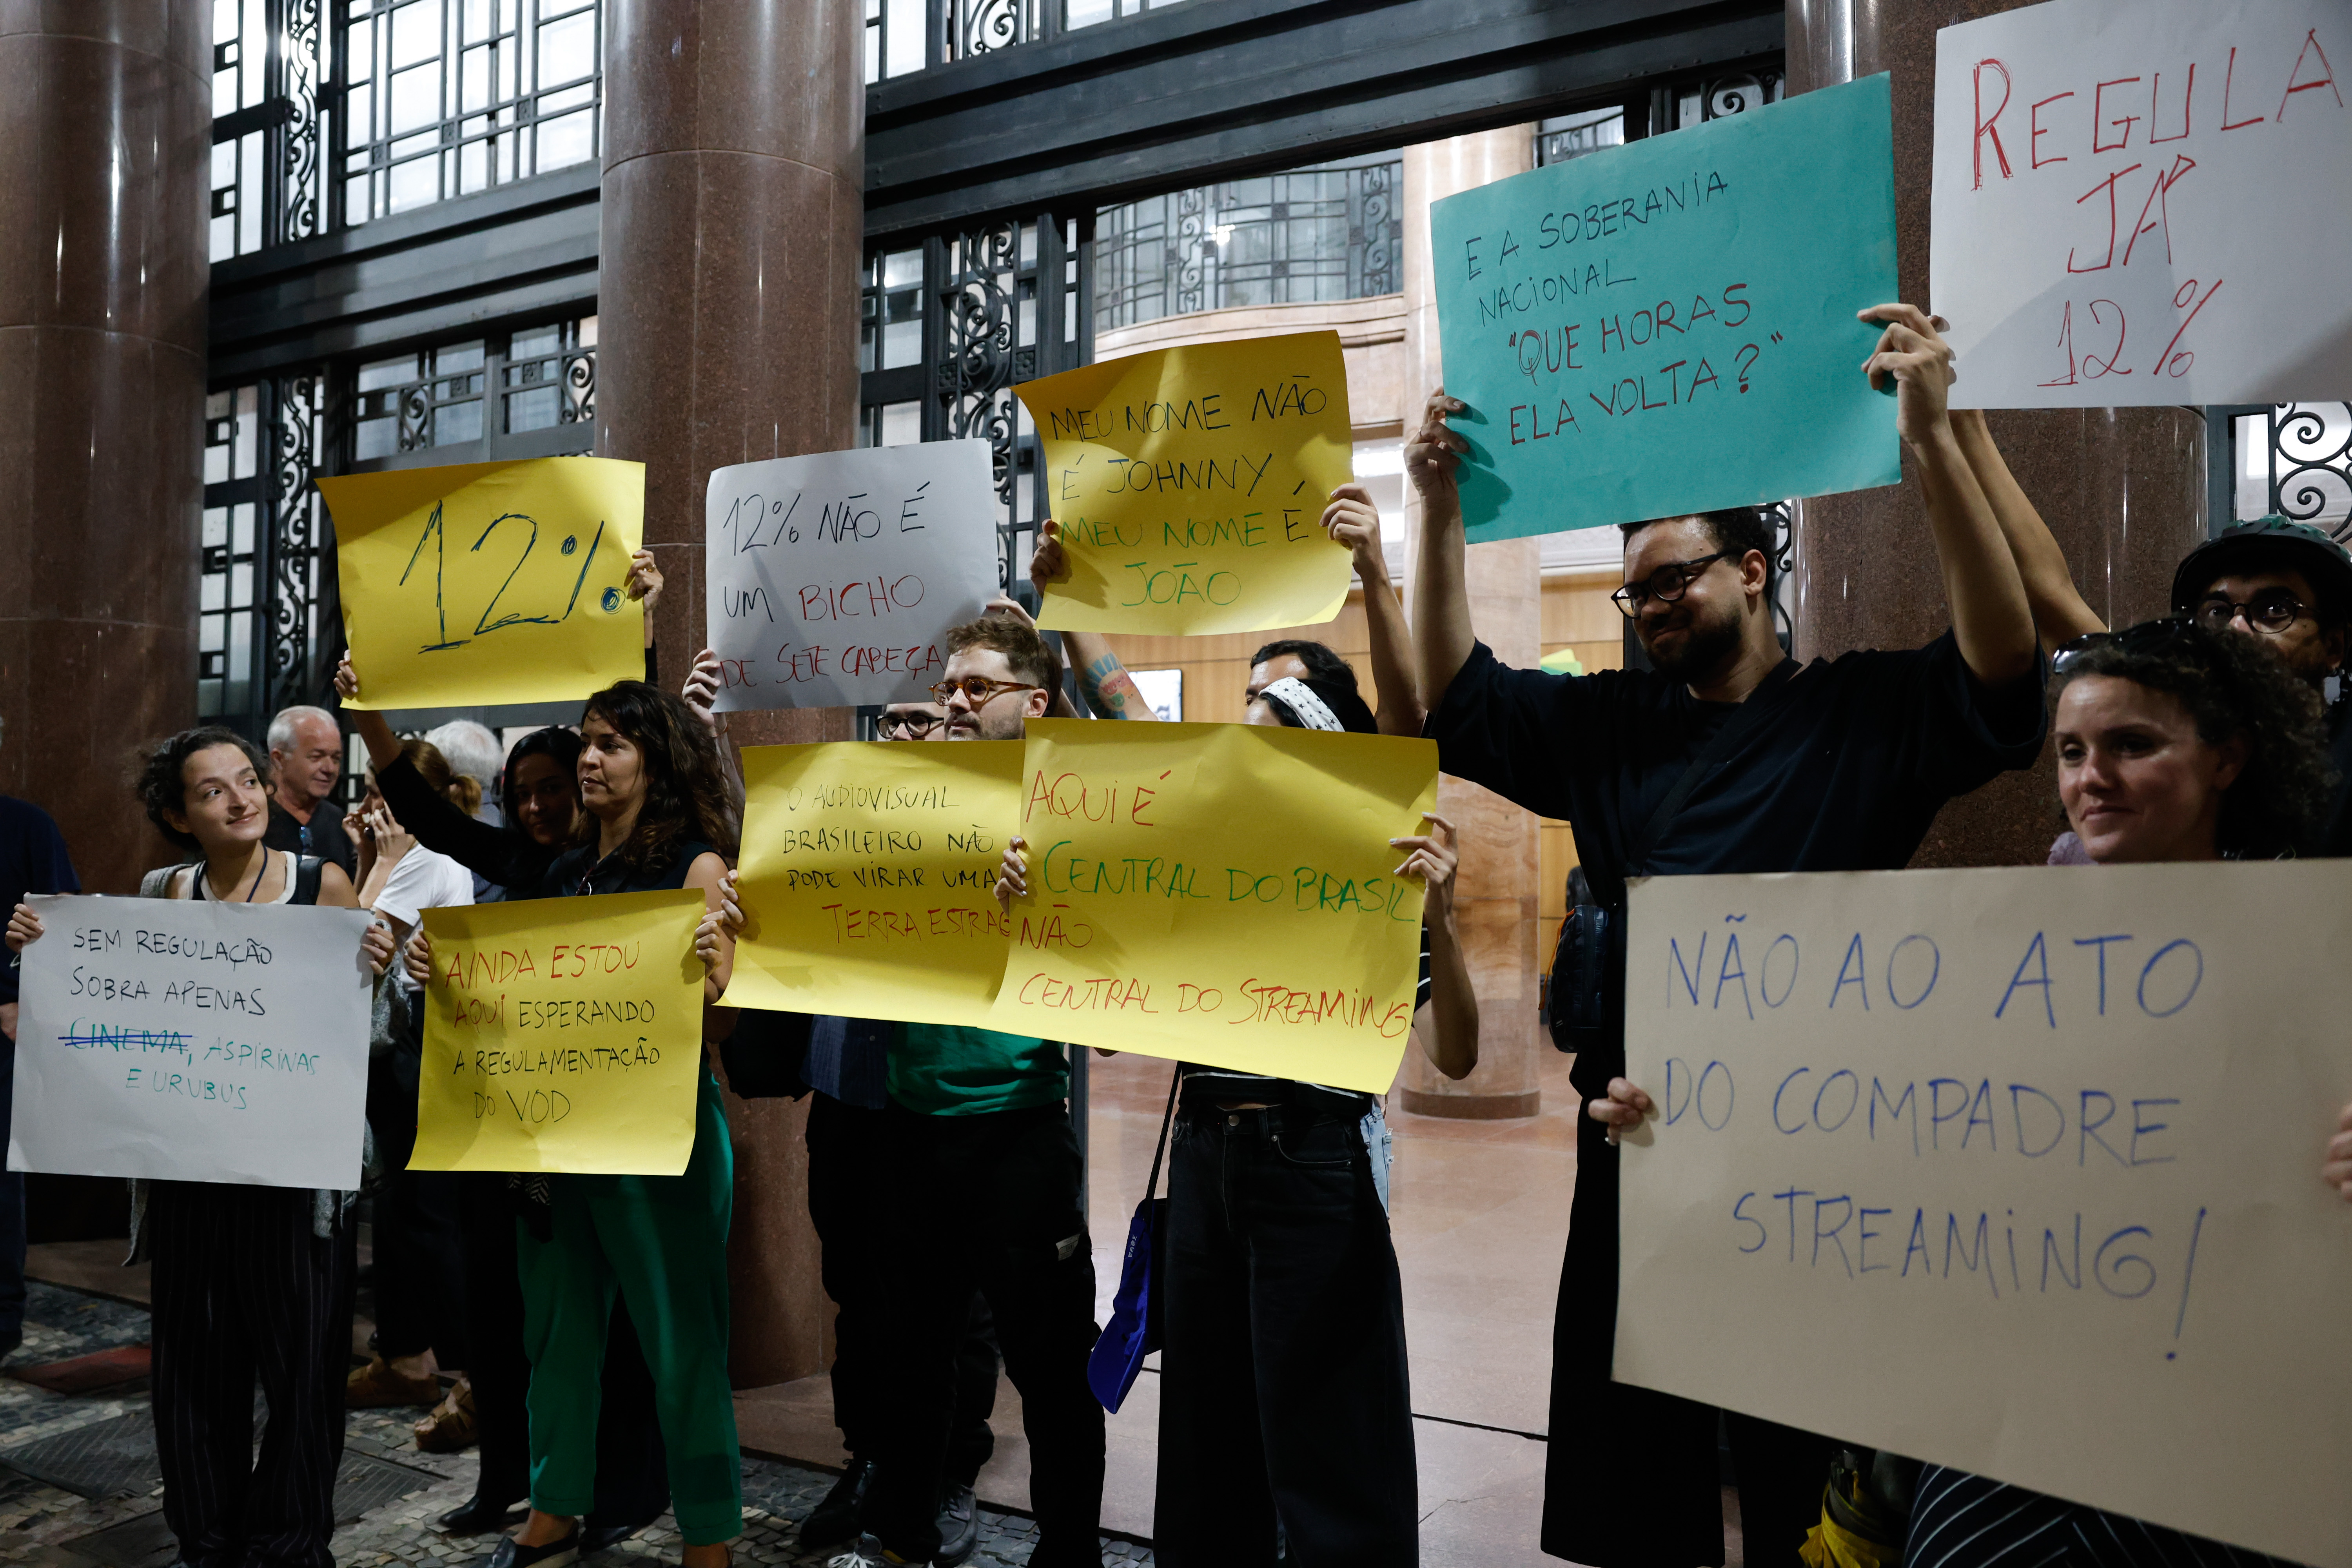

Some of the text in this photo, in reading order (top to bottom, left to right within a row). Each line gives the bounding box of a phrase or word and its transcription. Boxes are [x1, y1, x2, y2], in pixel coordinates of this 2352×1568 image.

[1971, 28, 2343, 192] REGULA
[1466, 171, 1728, 280] E A SOBERANIA
[2068, 154, 2196, 273] JÁ
[1479, 258, 1637, 327] NACIONAL
[1601, 283, 1750, 354] HORAS
[2037, 279, 2223, 387] 12%
[1051, 376, 1327, 442] MEU NOME NÃO
[1510, 399, 1581, 445] ELA
[1062, 453, 1272, 501] É JOHNNY
[724, 481, 930, 555] 12% NÃO É
[1061, 481, 1308, 548] MEU NOME É
[399, 500, 625, 654] 12%
[724, 575, 924, 622] UM BICHO
[1122, 562, 1241, 606] JOÃO
[720, 643, 945, 688] DE SETE CABEÇA
[788, 784, 960, 811] O AUDIOVISUAL
[1026, 770, 1171, 826] AQUI É
[784, 825, 993, 854] BRASILEIRO NÃO
[788, 861, 997, 891] PODE VIRAR UMA
[1044, 841, 1415, 922] CENTRAL DO BRASIL
[821, 904, 921, 944] TERRA
[1020, 904, 1093, 949] NÃO
[74, 927, 272, 971] SEM REGULAÇÃO
[445, 941, 639, 989] AINDA ESTOU
[1667, 914, 2204, 1029] NÃO AO ATO
[71, 966, 265, 1015] SOBRA APENAS
[454, 994, 654, 1034] AQUI ESPERANDO
[1019, 973, 1409, 1038] CENTRAL DO STREAMING
[204, 1036, 320, 1075] ASPIRINAS
[454, 1037, 660, 1075] A REGULAMENTAÇÃO
[126, 1069, 246, 1109] E URUBUS
[474, 1089, 570, 1123] DO VOD
[1665, 1057, 2181, 1167] DO COMPADRE
